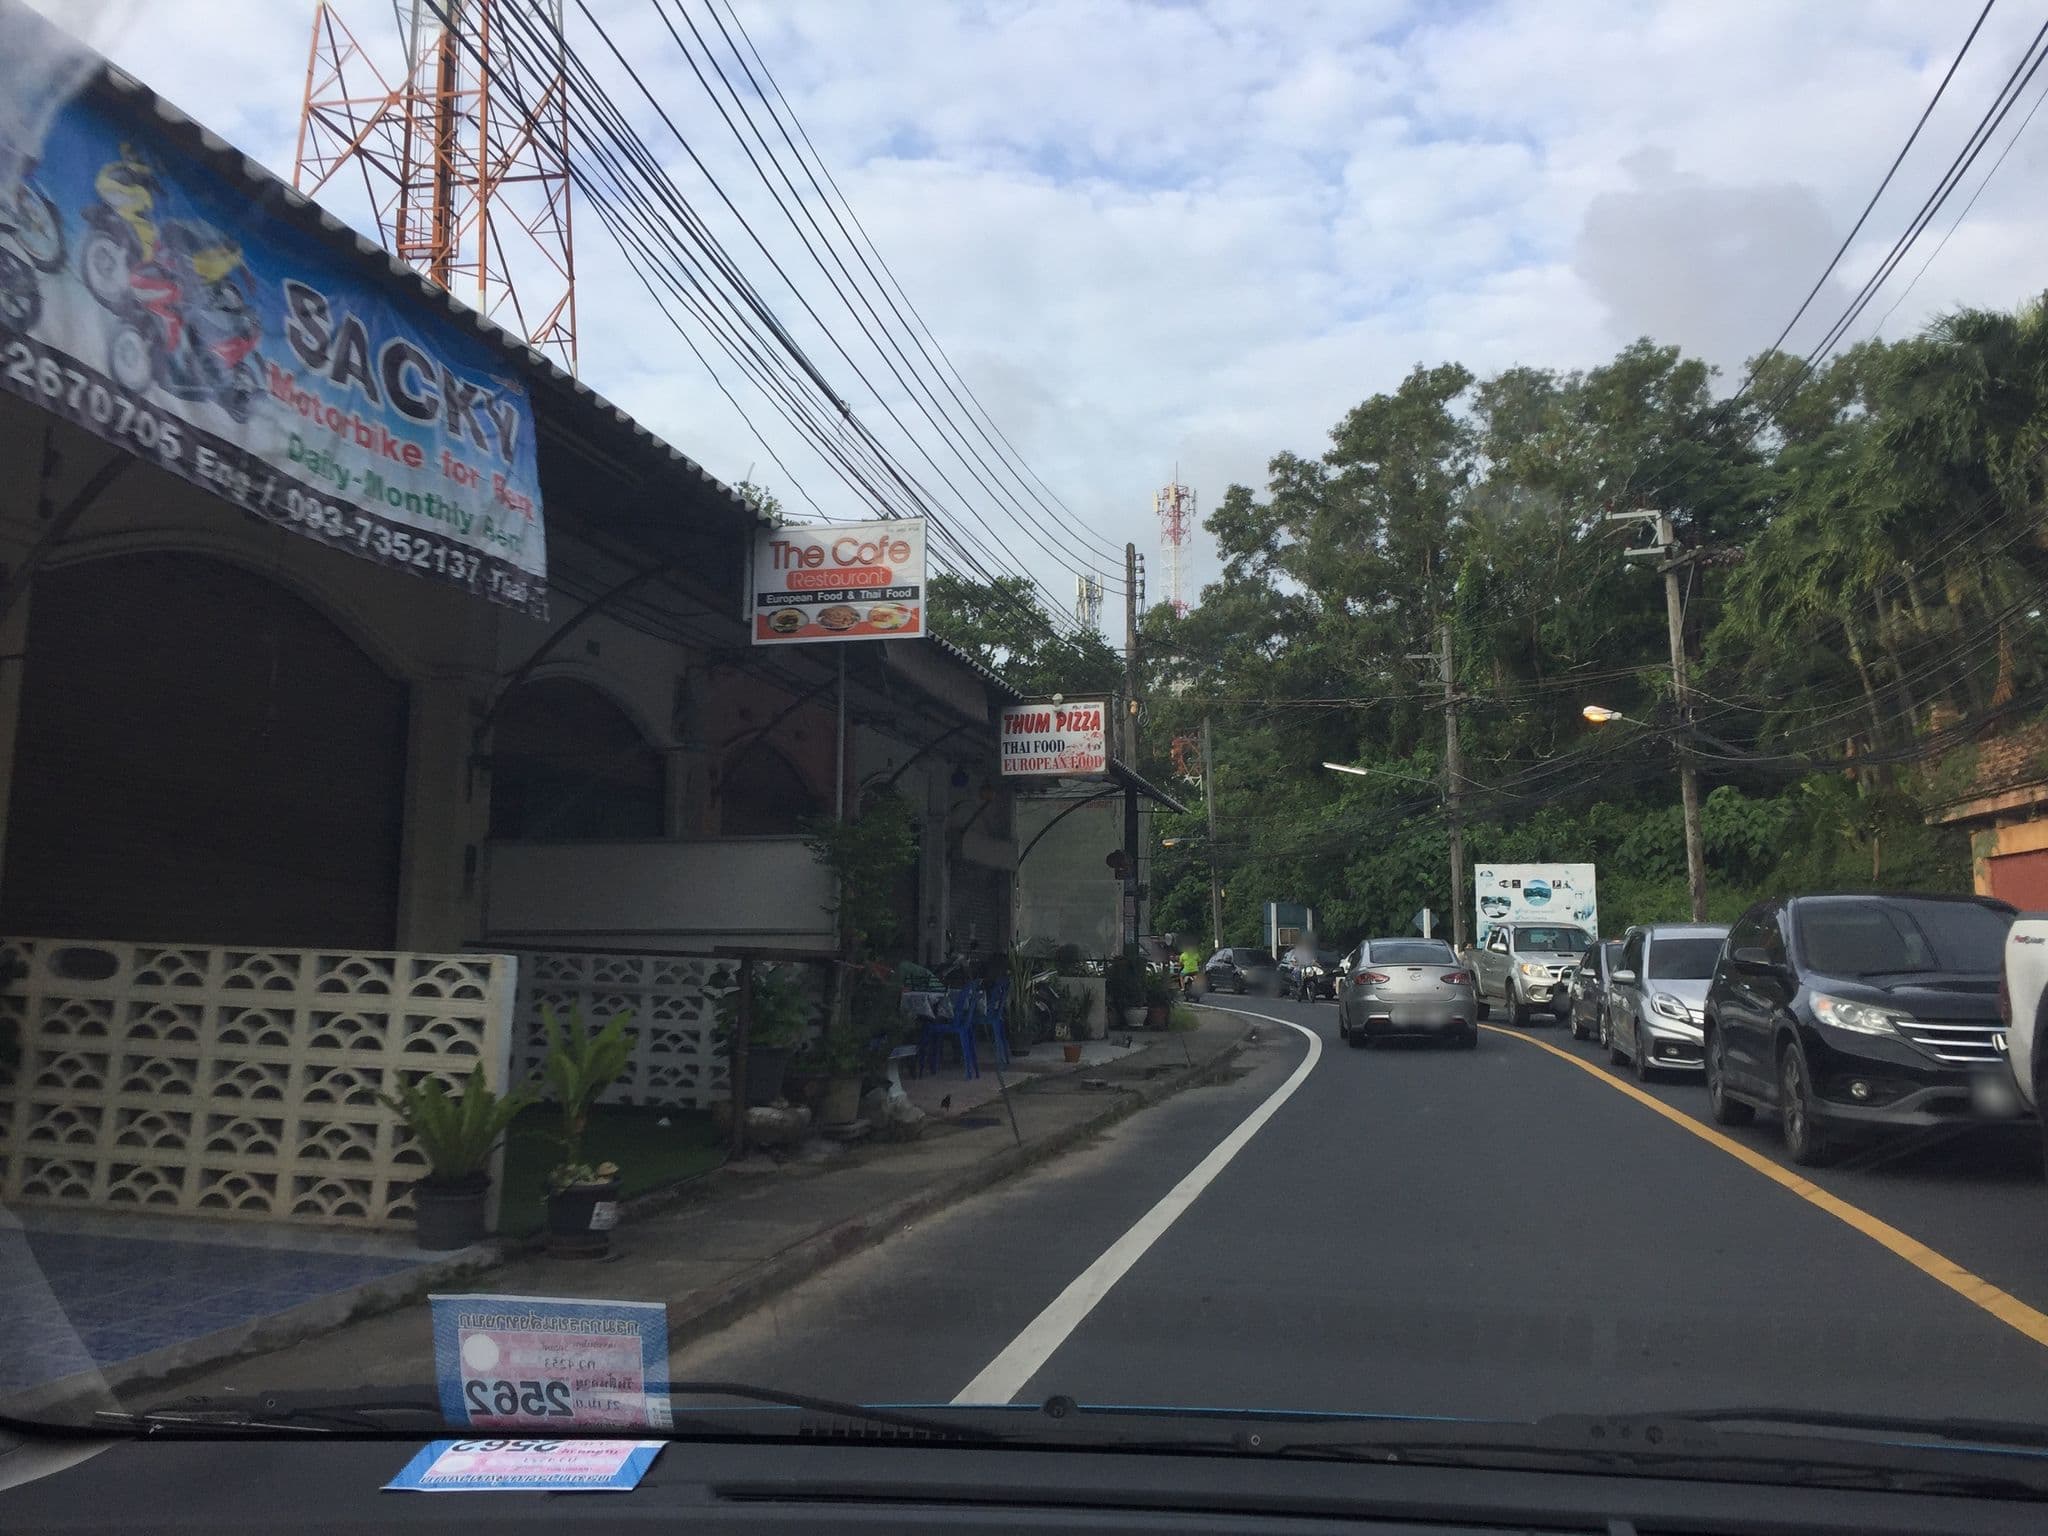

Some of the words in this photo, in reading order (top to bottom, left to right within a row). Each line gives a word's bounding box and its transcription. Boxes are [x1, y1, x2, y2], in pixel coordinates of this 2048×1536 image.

[284, 279, 519, 464] SACKY
[268, 363, 423, 468] Motorbike
[442, 452, 481, 491] for
[288, 432, 474, 536] Daily-Monthly
[288, 488, 481, 584] 093-7352137
[769, 540, 825, 569] The
[831, 535, 911, 567] Cafe
[792, 568, 886, 588] Restaurant
[766, 593, 813, 605] European
[817, 591, 843, 601] Food
[847, 591, 855, 600] &
[859, 590, 882, 600] Thai
[886, 587, 912, 599] Food
[1003, 712, 1051, 735] THUM
[1055, 710, 1101, 733] PIZZA
[1003, 741, 1031, 755] THAI
[1034, 739, 1065, 753] FOOD
